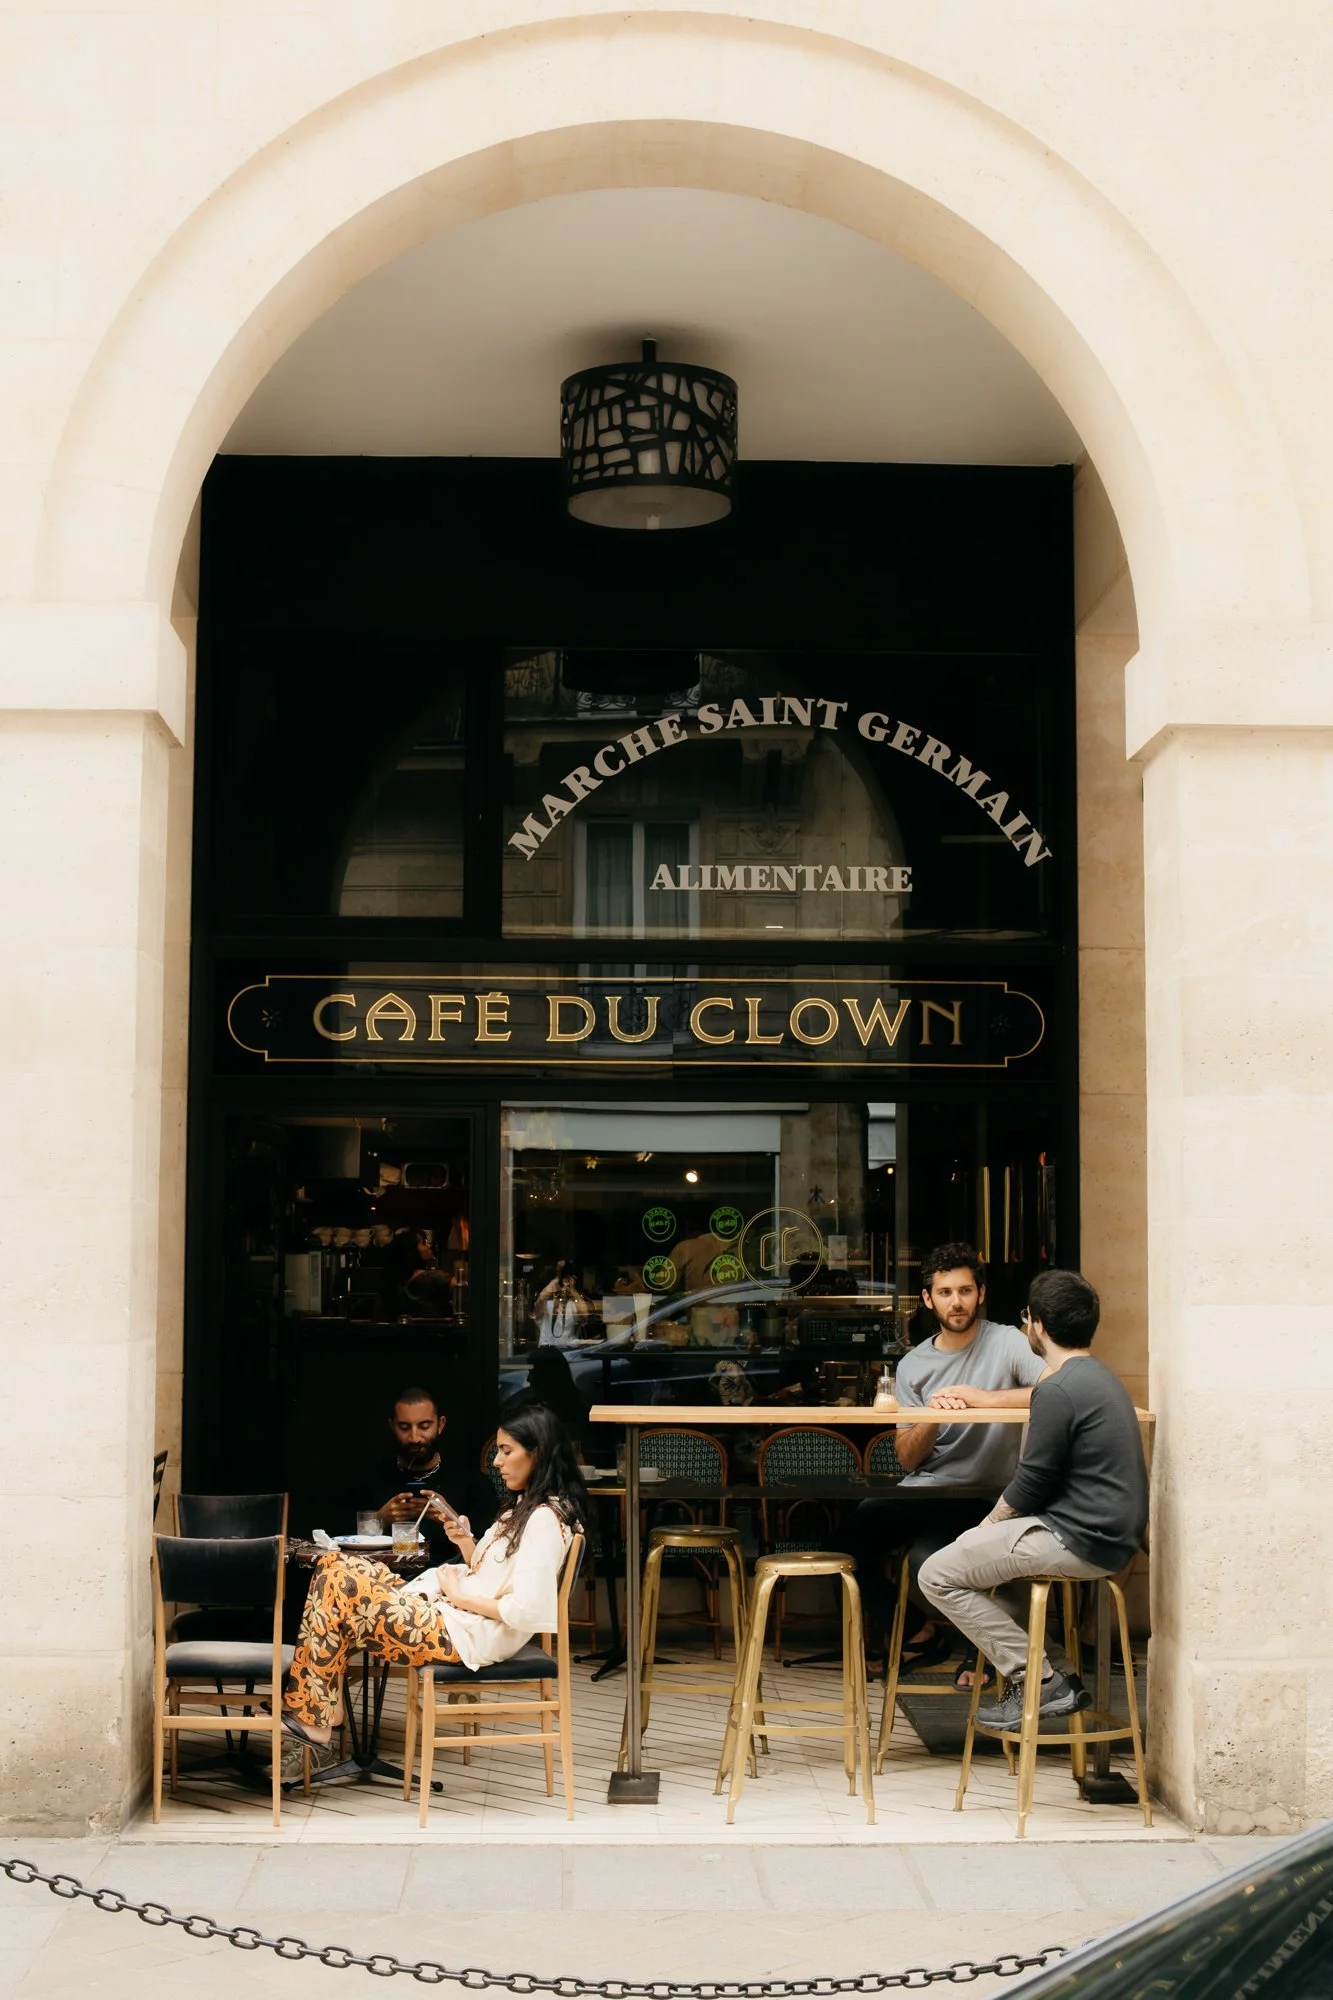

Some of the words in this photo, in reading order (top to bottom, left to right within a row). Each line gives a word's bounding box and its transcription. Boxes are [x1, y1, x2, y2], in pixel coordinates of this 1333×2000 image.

[508, 714, 688, 860] MARCHE
[697, 697, 848, 735] SAINT
[857, 711, 1053, 868] GERMAIN
[649, 863, 913, 893] ALIMENTAIRE
[313, 992, 512, 1042] CAFÉ
[546, 995, 661, 1043] DU
[690, 997, 963, 1047] CLOWN
